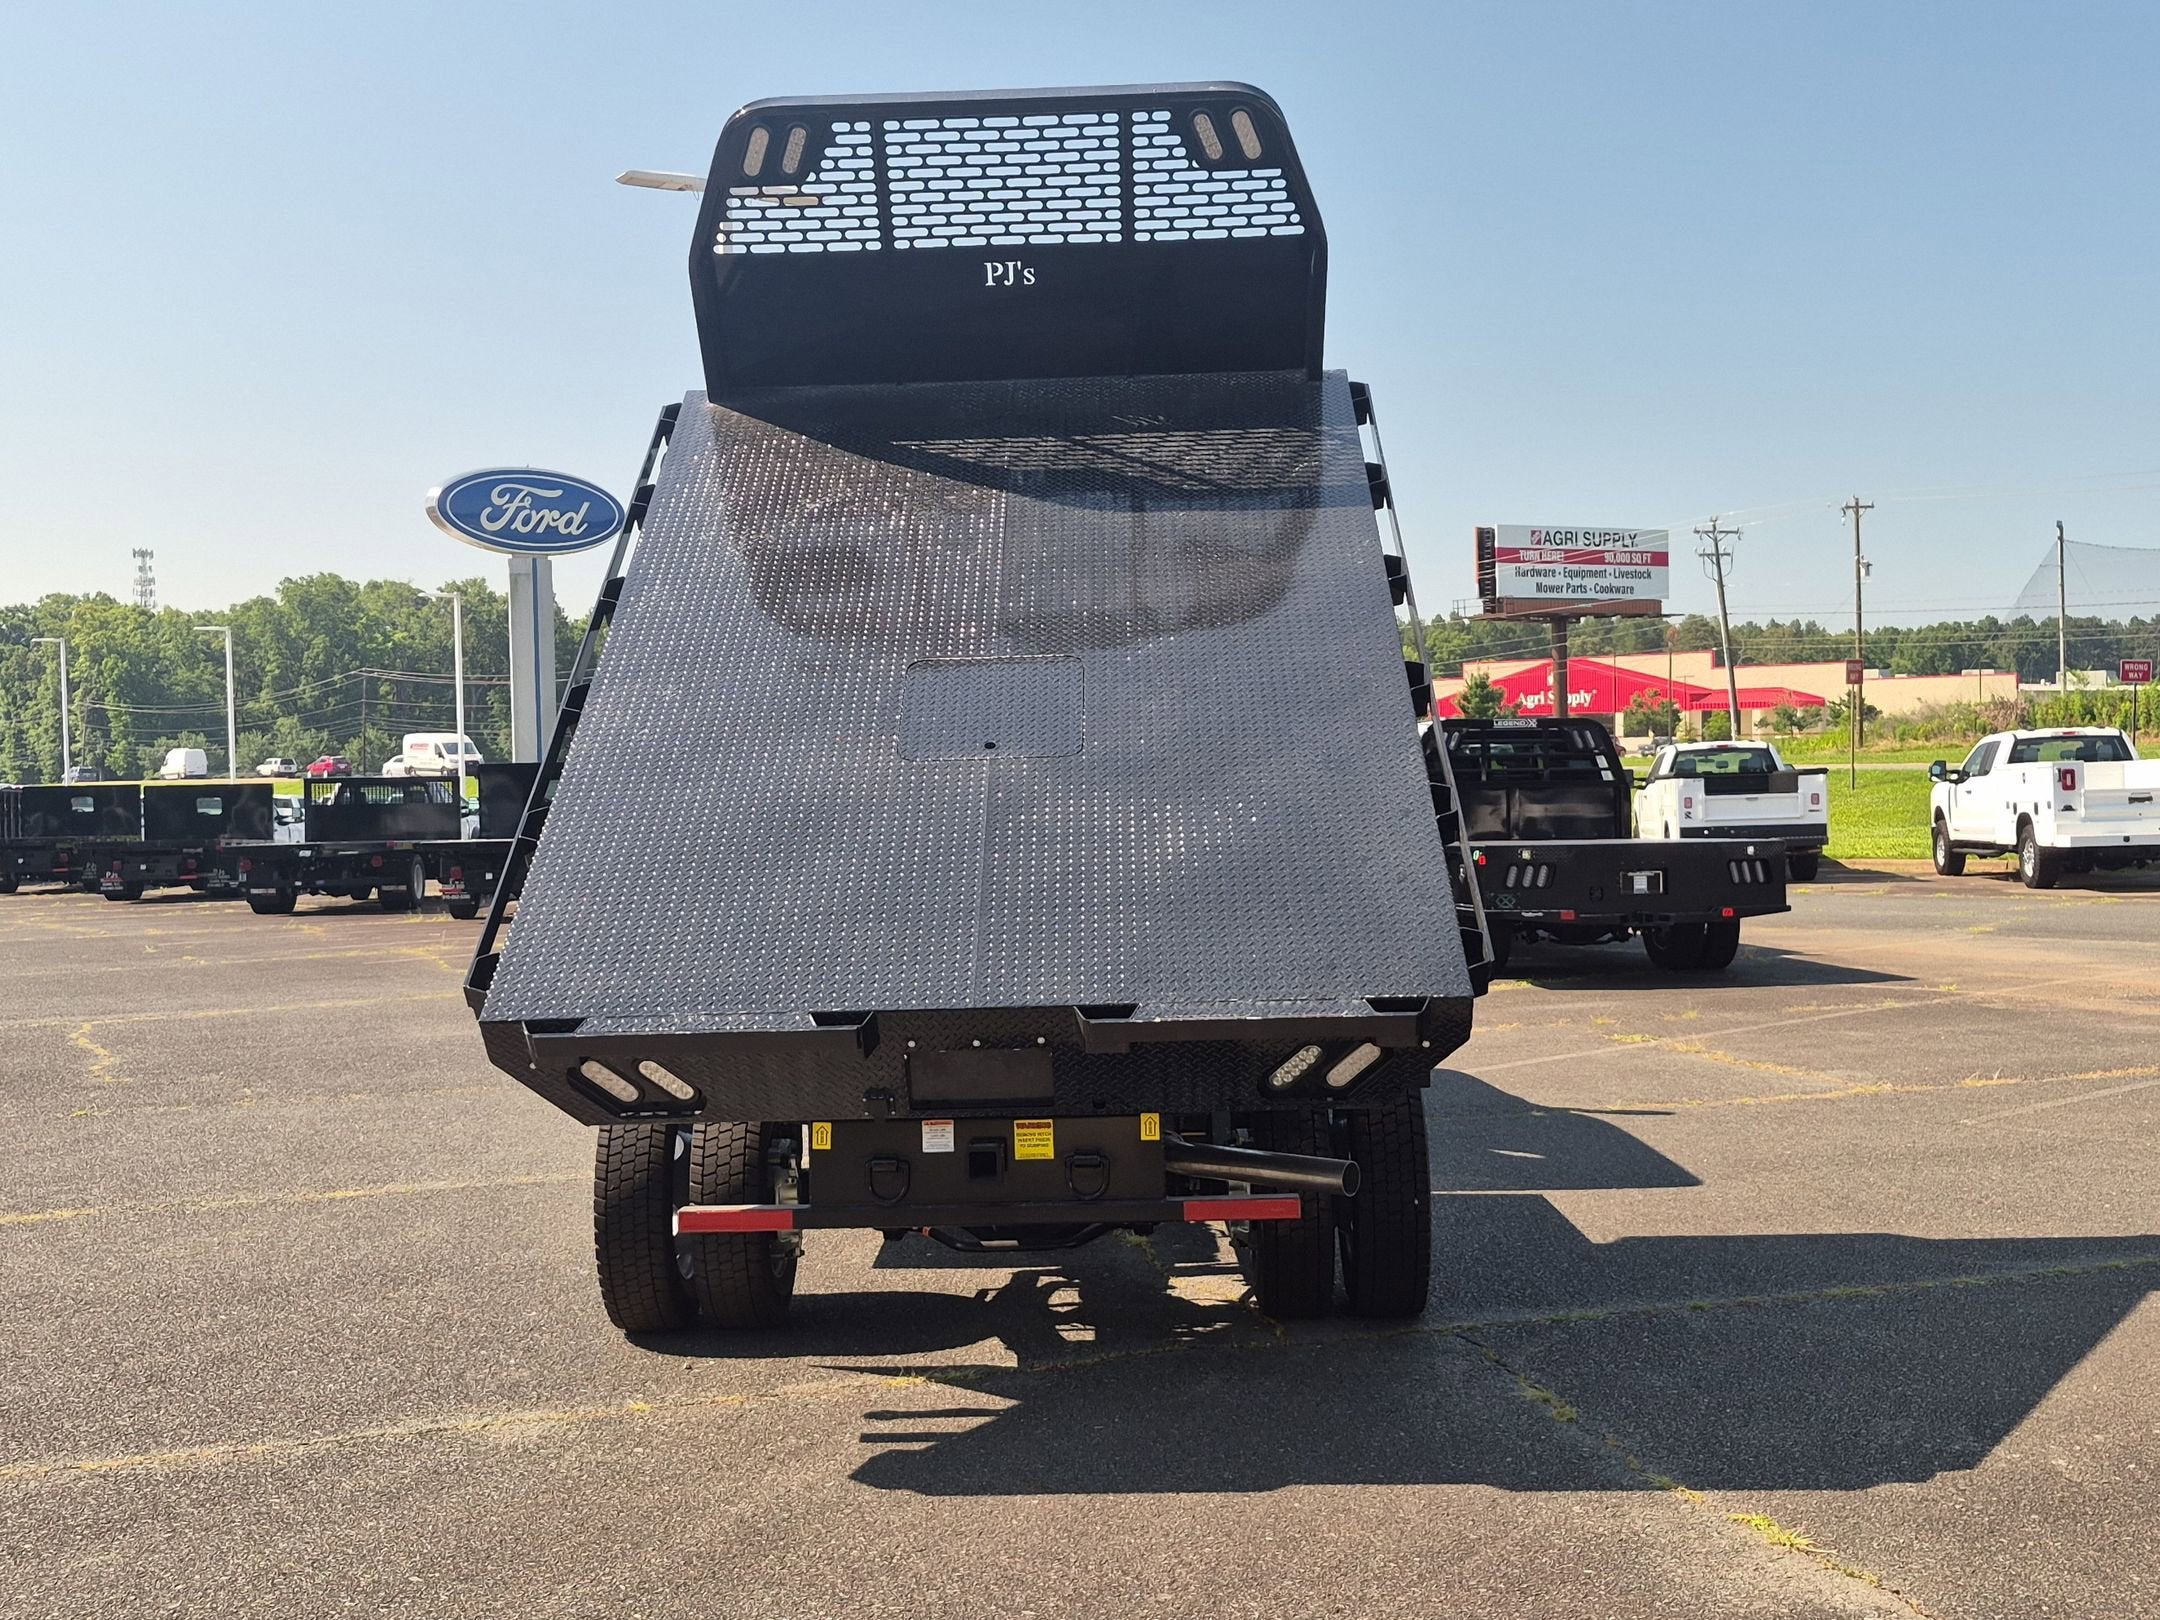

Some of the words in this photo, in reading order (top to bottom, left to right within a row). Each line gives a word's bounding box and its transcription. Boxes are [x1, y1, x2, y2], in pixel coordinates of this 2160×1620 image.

[983, 260, 1036, 286] PJ's
[480, 483, 591, 536] Ford
[1543, 530, 1578, 546] AGRI
[1583, 531, 1638, 548] SUPPLY
[1519, 549, 1541, 561] TURN
[1604, 551, 1631, 564] 90,000
[1631, 552, 1642, 564] SQ
[1643, 553, 1652, 564] FT
[1514, 565, 1557, 578] Hardware
[1563, 566, 1607, 581] Equipment
[1613, 567, 1652, 580] Livestock
[1535, 582, 1564, 594] Mower
[1566, 582, 1588, 594] Parts
[1594, 582, 1635, 595] Cookware
[2124, 663, 2149, 671] WRONG
[2128, 671, 2144, 679] WAY
[1518, 690, 1545, 709] Agri
